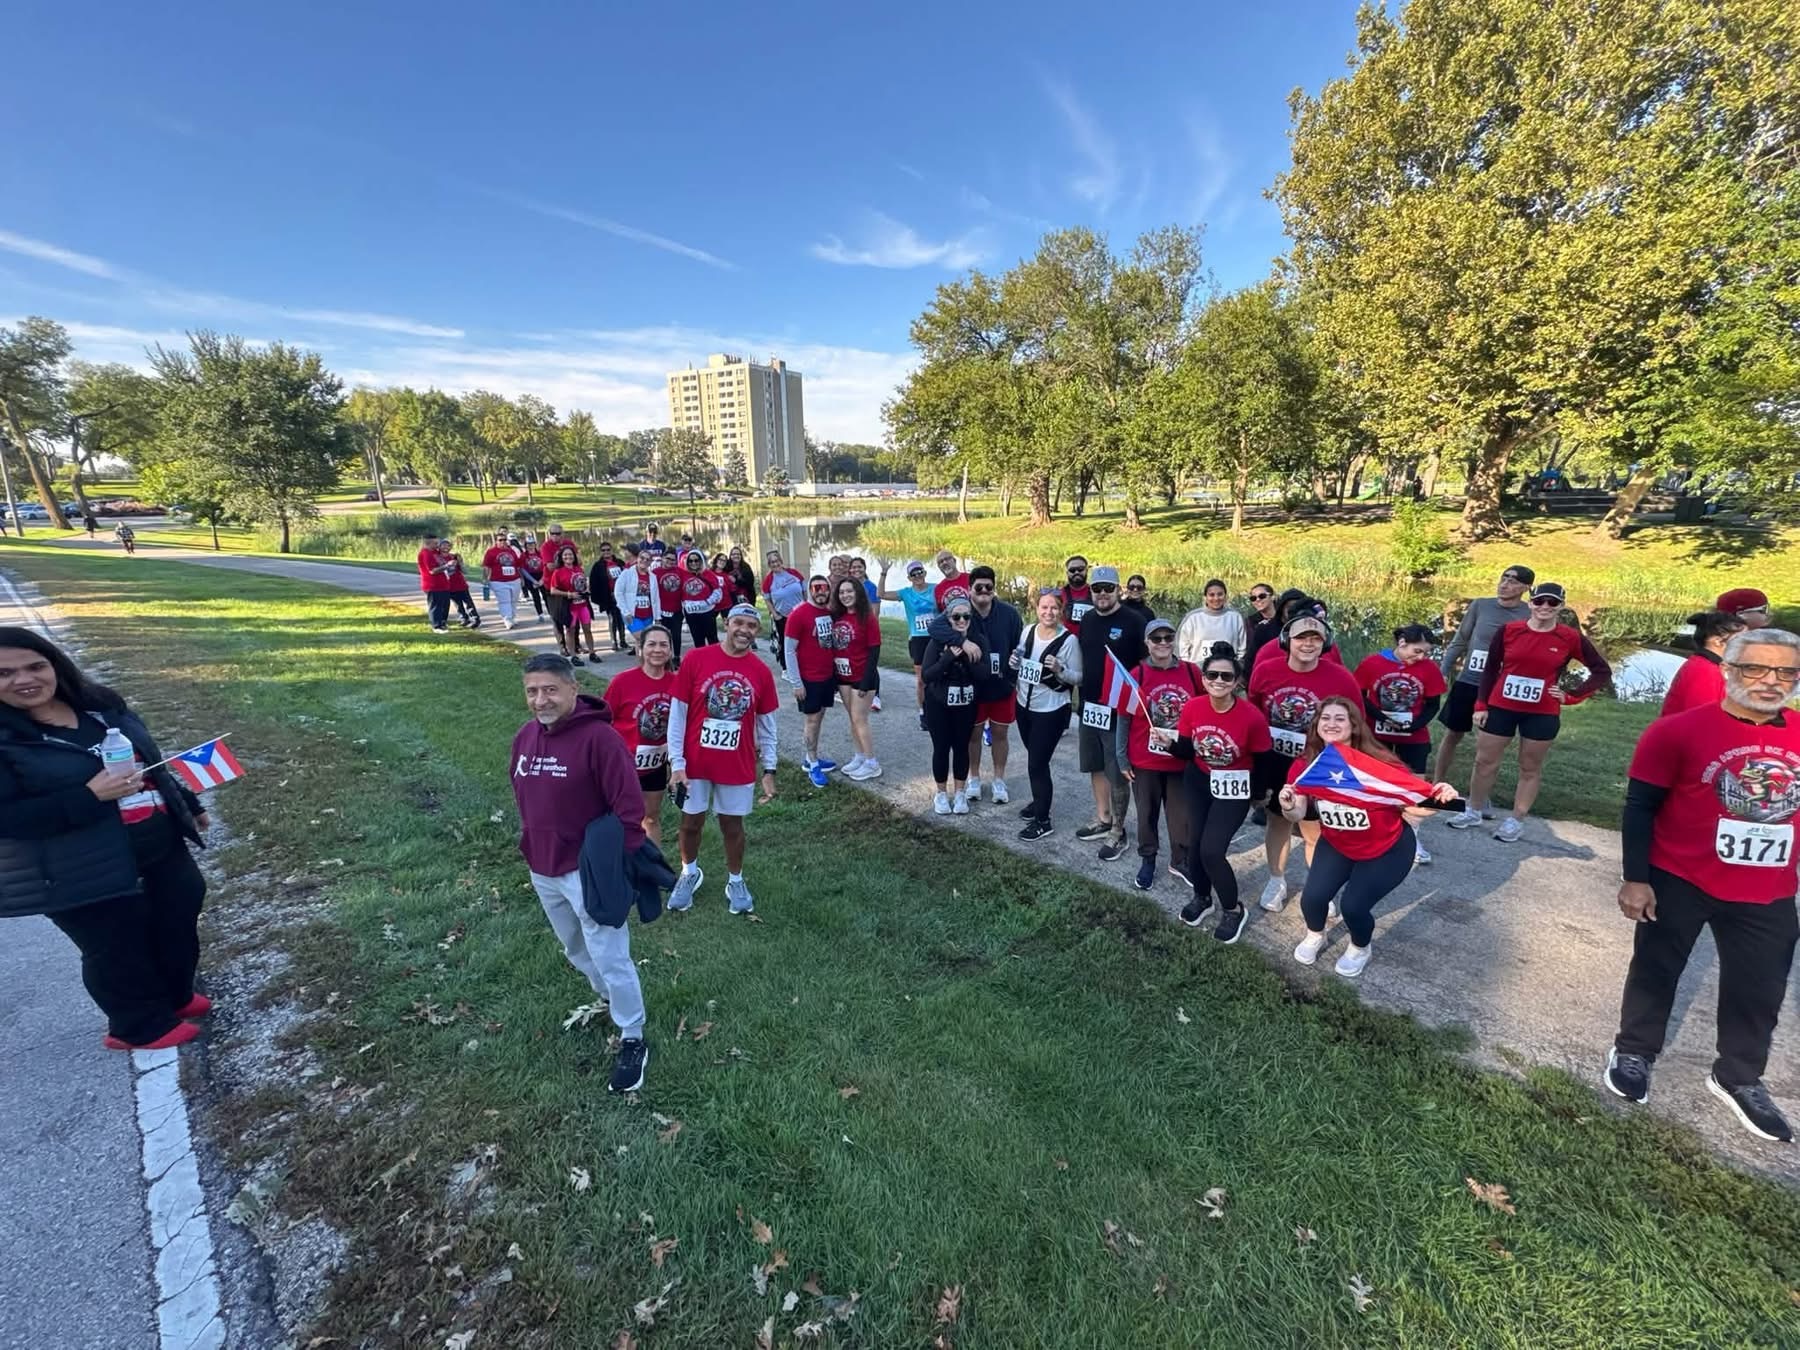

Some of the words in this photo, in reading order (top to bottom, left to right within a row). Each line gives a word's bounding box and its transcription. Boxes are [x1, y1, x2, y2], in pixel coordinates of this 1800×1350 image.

[1073, 608, 1083, 620] 33
[1470, 656, 1485, 670] 31
[1019, 665, 1040, 682] 3338
[1503, 682, 1541, 701] 3195
[1083, 709, 1110, 727] 3337
[702, 728, 738, 748] 3328
[1272, 737, 1304, 756] 335
[637, 752, 667, 768] 3164
[1211, 779, 1249, 797] 3184
[1321, 810, 1368, 828] 3182
[1718, 833, 1788, 862] 3171
